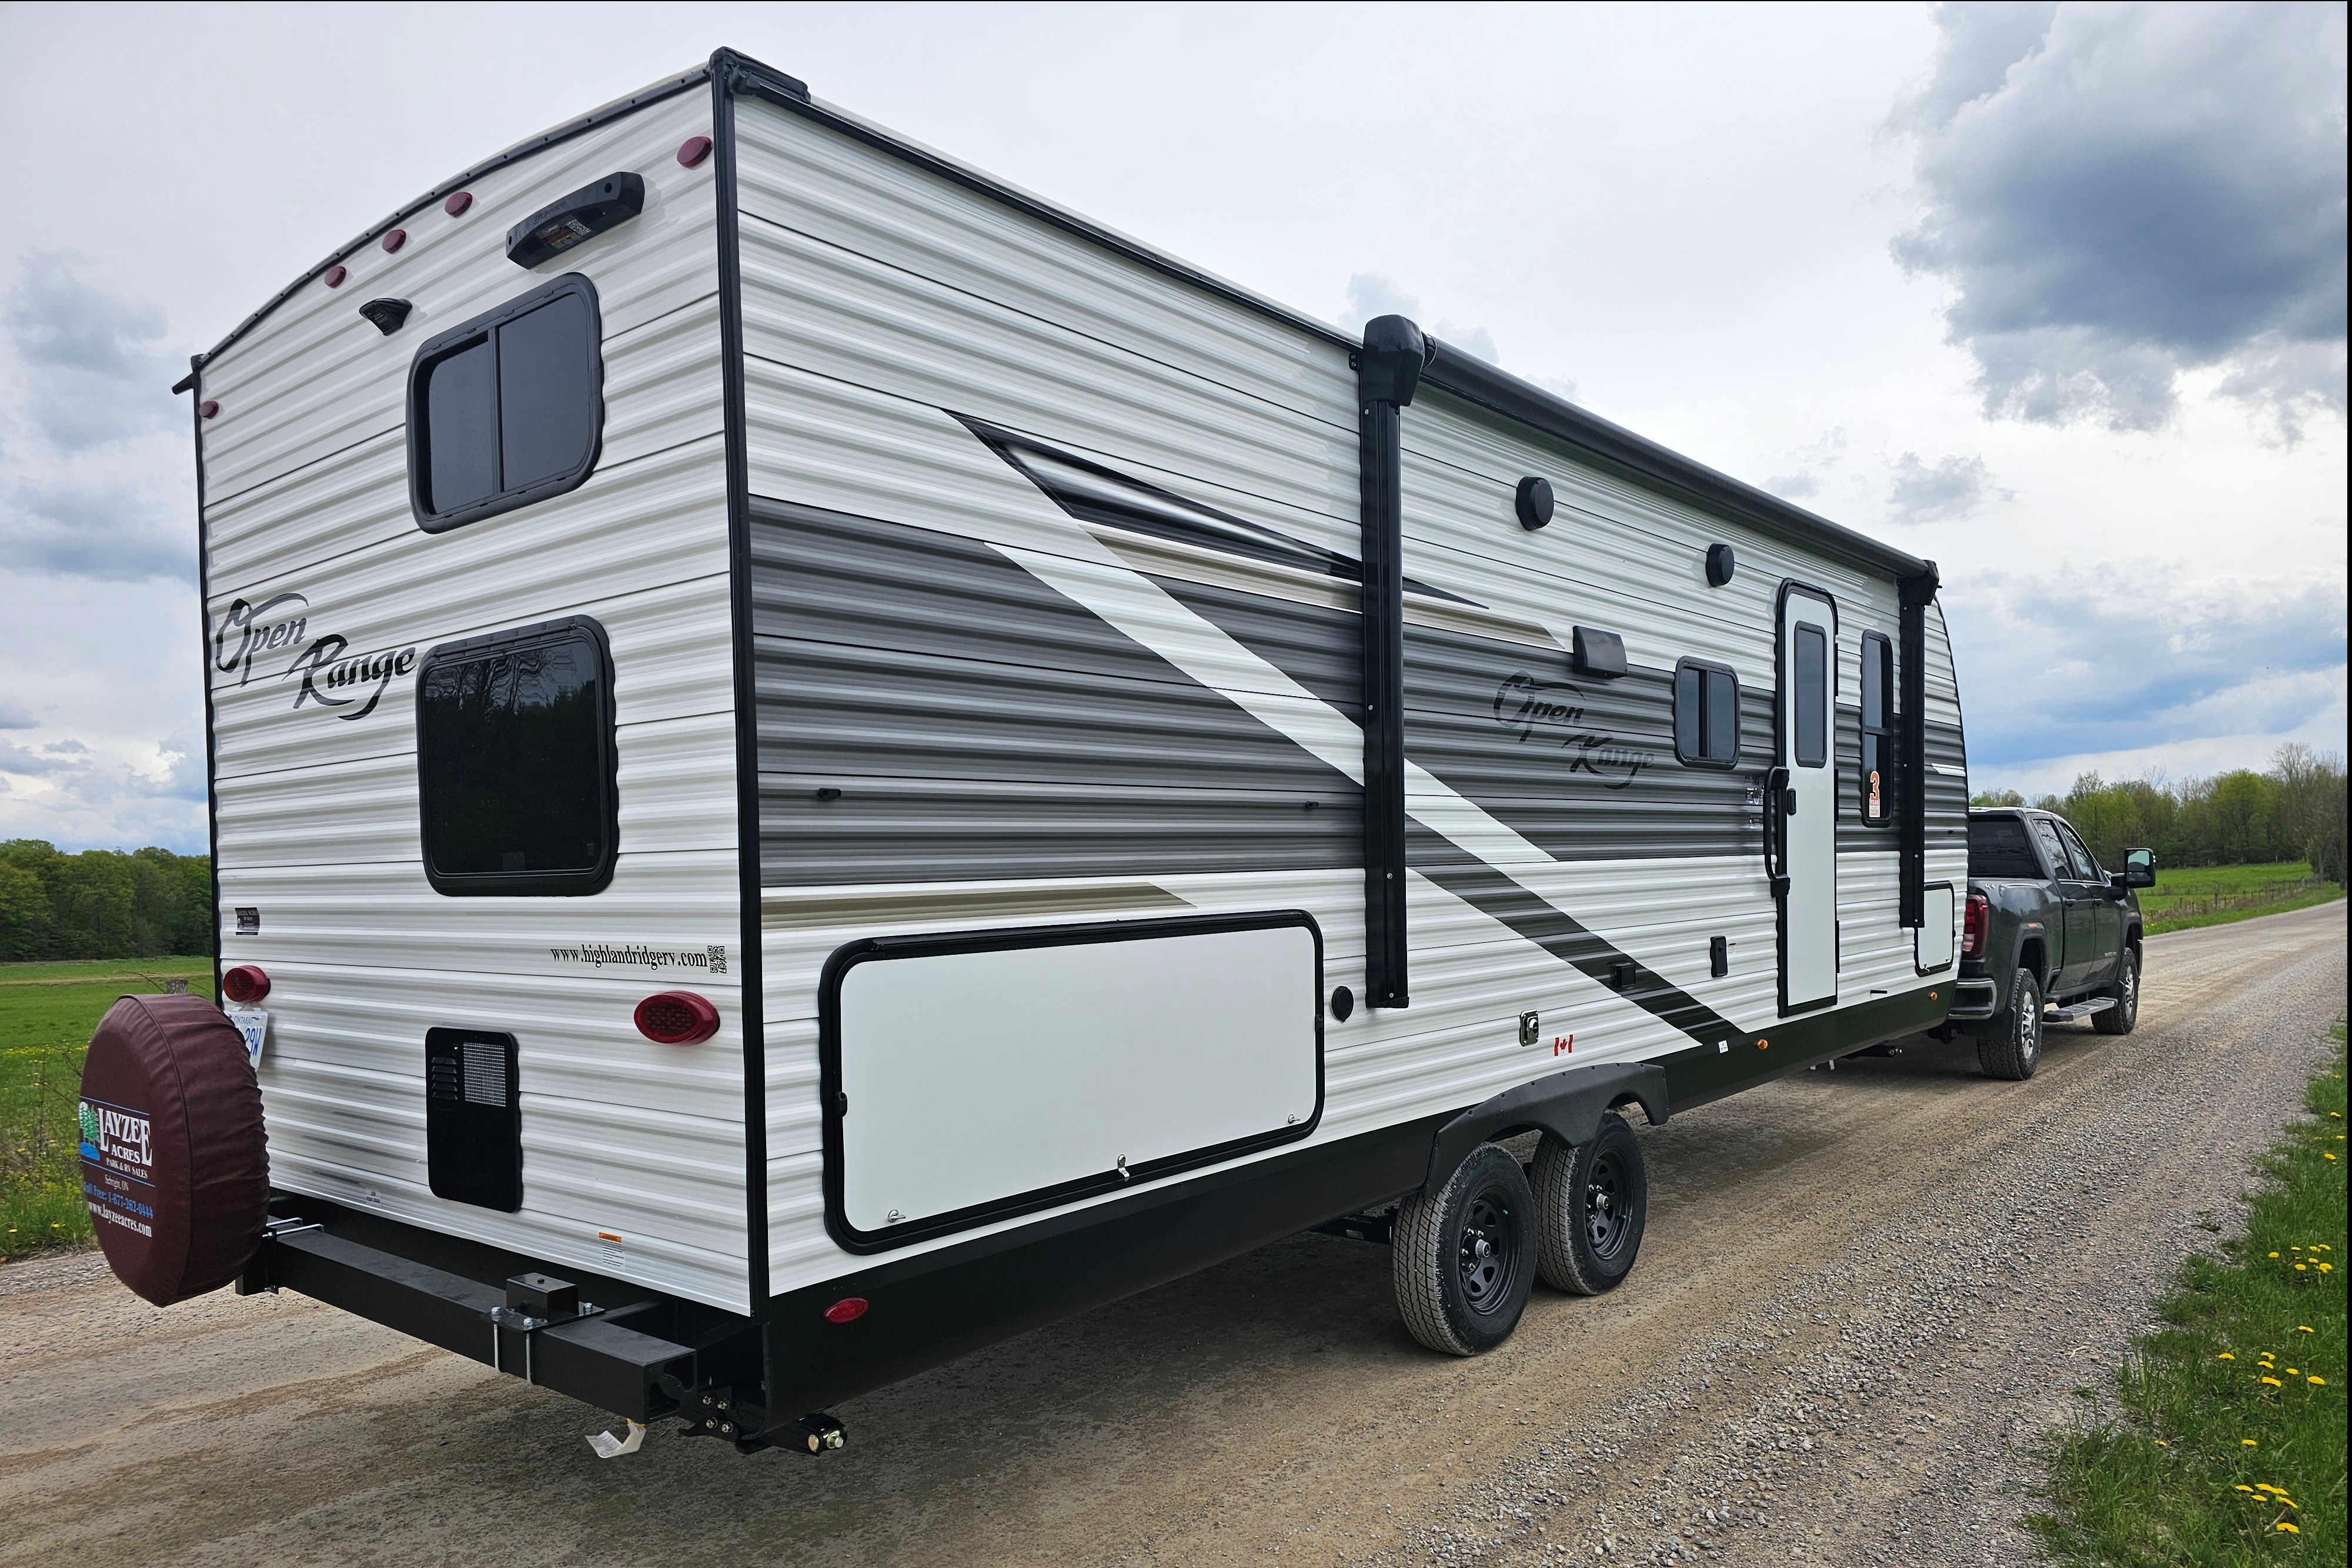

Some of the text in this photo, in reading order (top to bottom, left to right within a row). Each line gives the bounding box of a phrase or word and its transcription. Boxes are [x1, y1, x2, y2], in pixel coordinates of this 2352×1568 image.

[216, 593, 309, 688] Open
[282, 634, 417, 721] Range
[1492, 670, 1587, 744] Open
[1561, 730, 1655, 790] Range
[1870, 771, 1880, 800] 3
[550, 944, 708, 971] www.highlandridgerv.com
[98, 1108, 152, 1167] LAYZEE
[111, 1144, 141, 1164] ACRES
[106, 1157, 119, 1170] PARK
[124, 1164, 131, 1173] RV
[132, 1166, 148, 1179] SALES
[87, 1201, 152, 1238] www.layzeeacres.com
